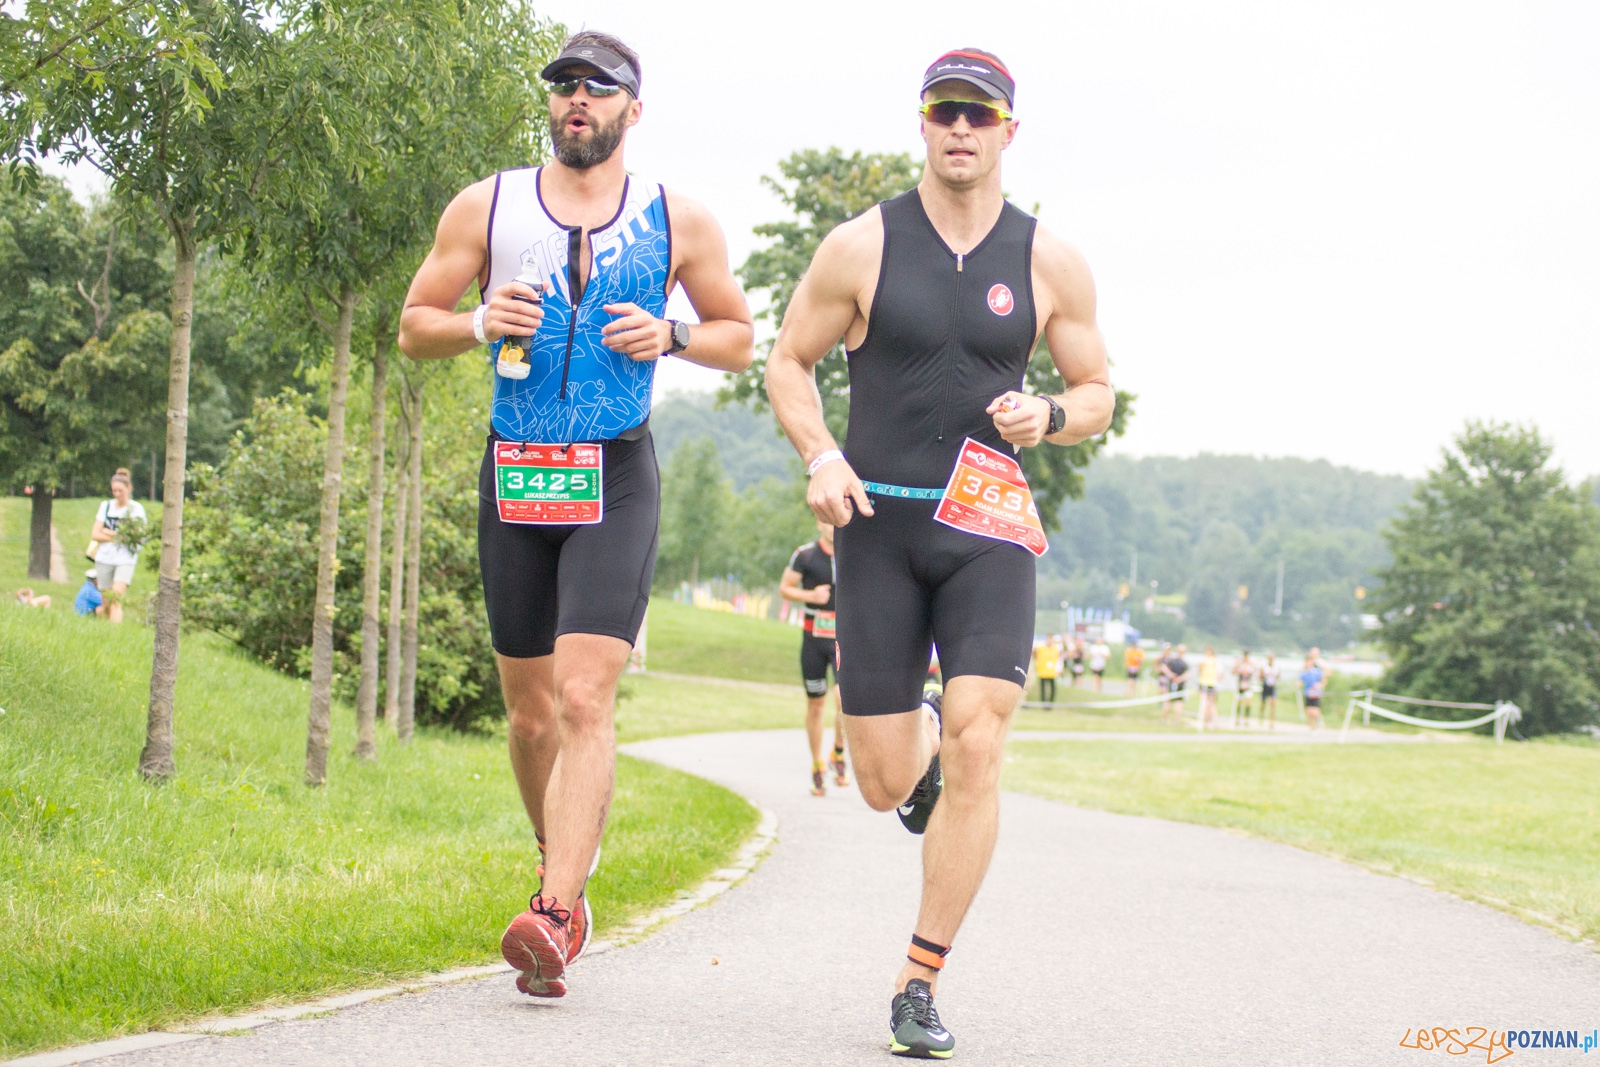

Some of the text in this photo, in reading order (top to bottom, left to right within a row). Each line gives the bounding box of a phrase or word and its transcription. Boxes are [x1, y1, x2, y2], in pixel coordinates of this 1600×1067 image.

[507, 472, 588, 490] 3425
[974, 501, 994, 513] ADAM
[993, 508, 1025, 522] SUCHECKI
